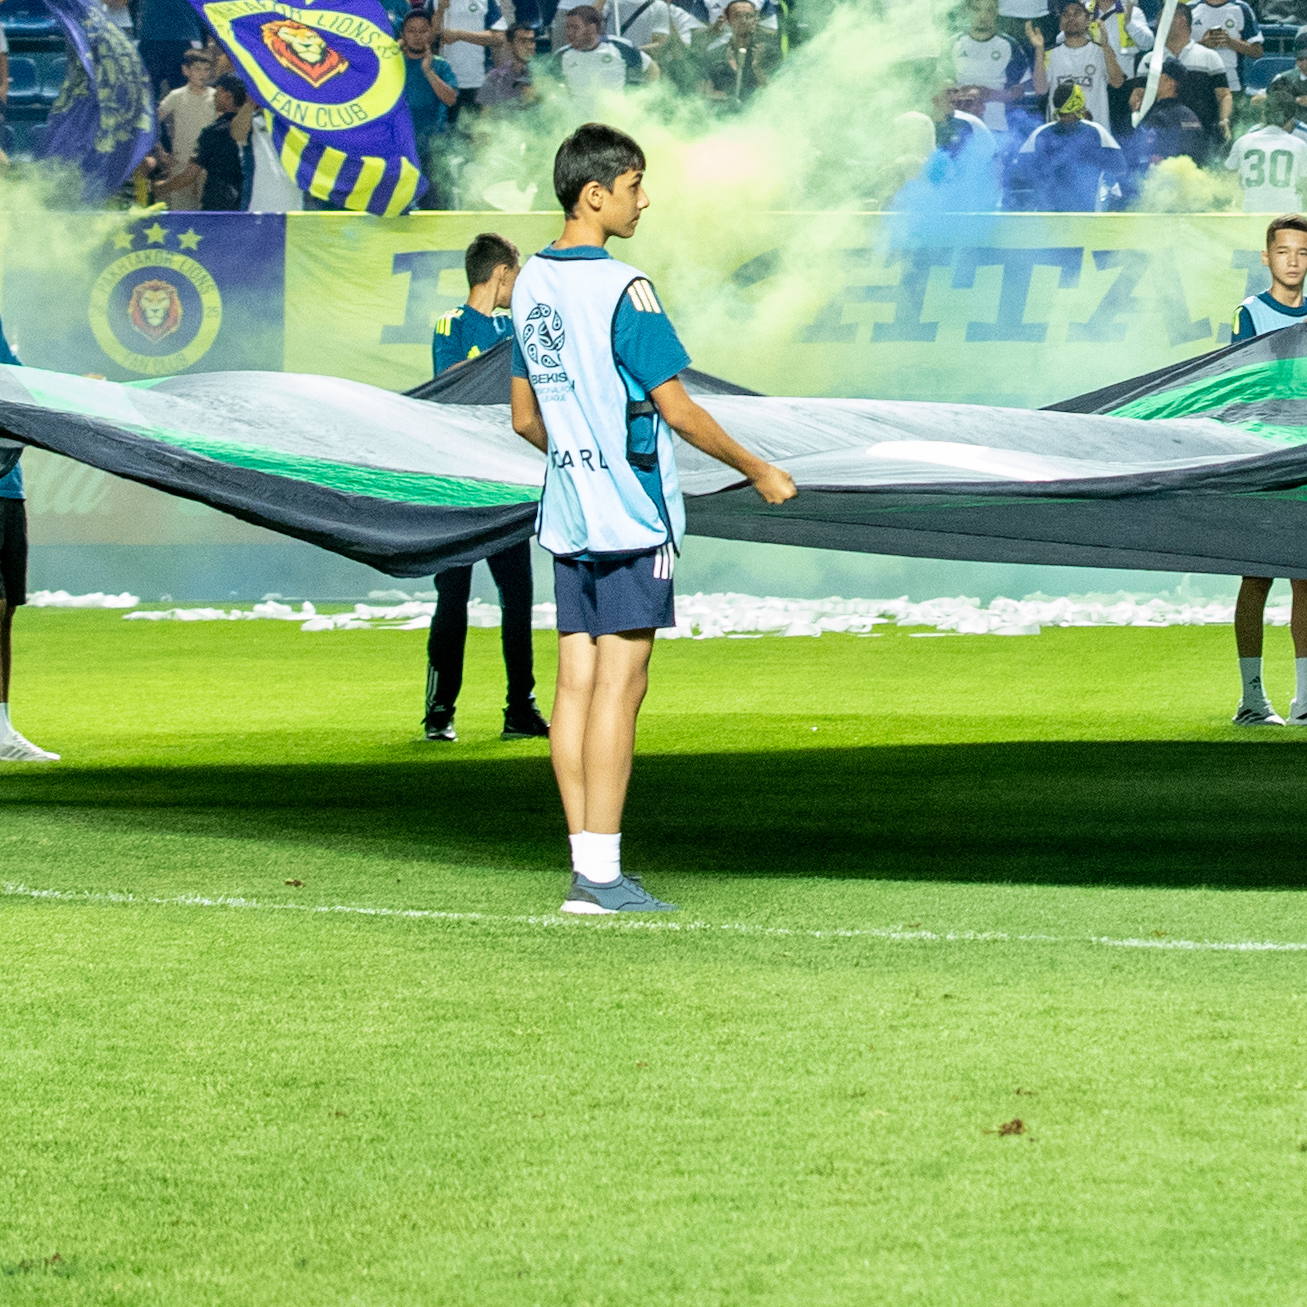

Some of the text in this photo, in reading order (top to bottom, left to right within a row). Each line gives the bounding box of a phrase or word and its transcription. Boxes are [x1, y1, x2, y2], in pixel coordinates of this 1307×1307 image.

[316, 13, 382, 46] LIONS
[270, 91, 369, 129] FAN CLUB
[1243, 148, 1295, 188] 30
